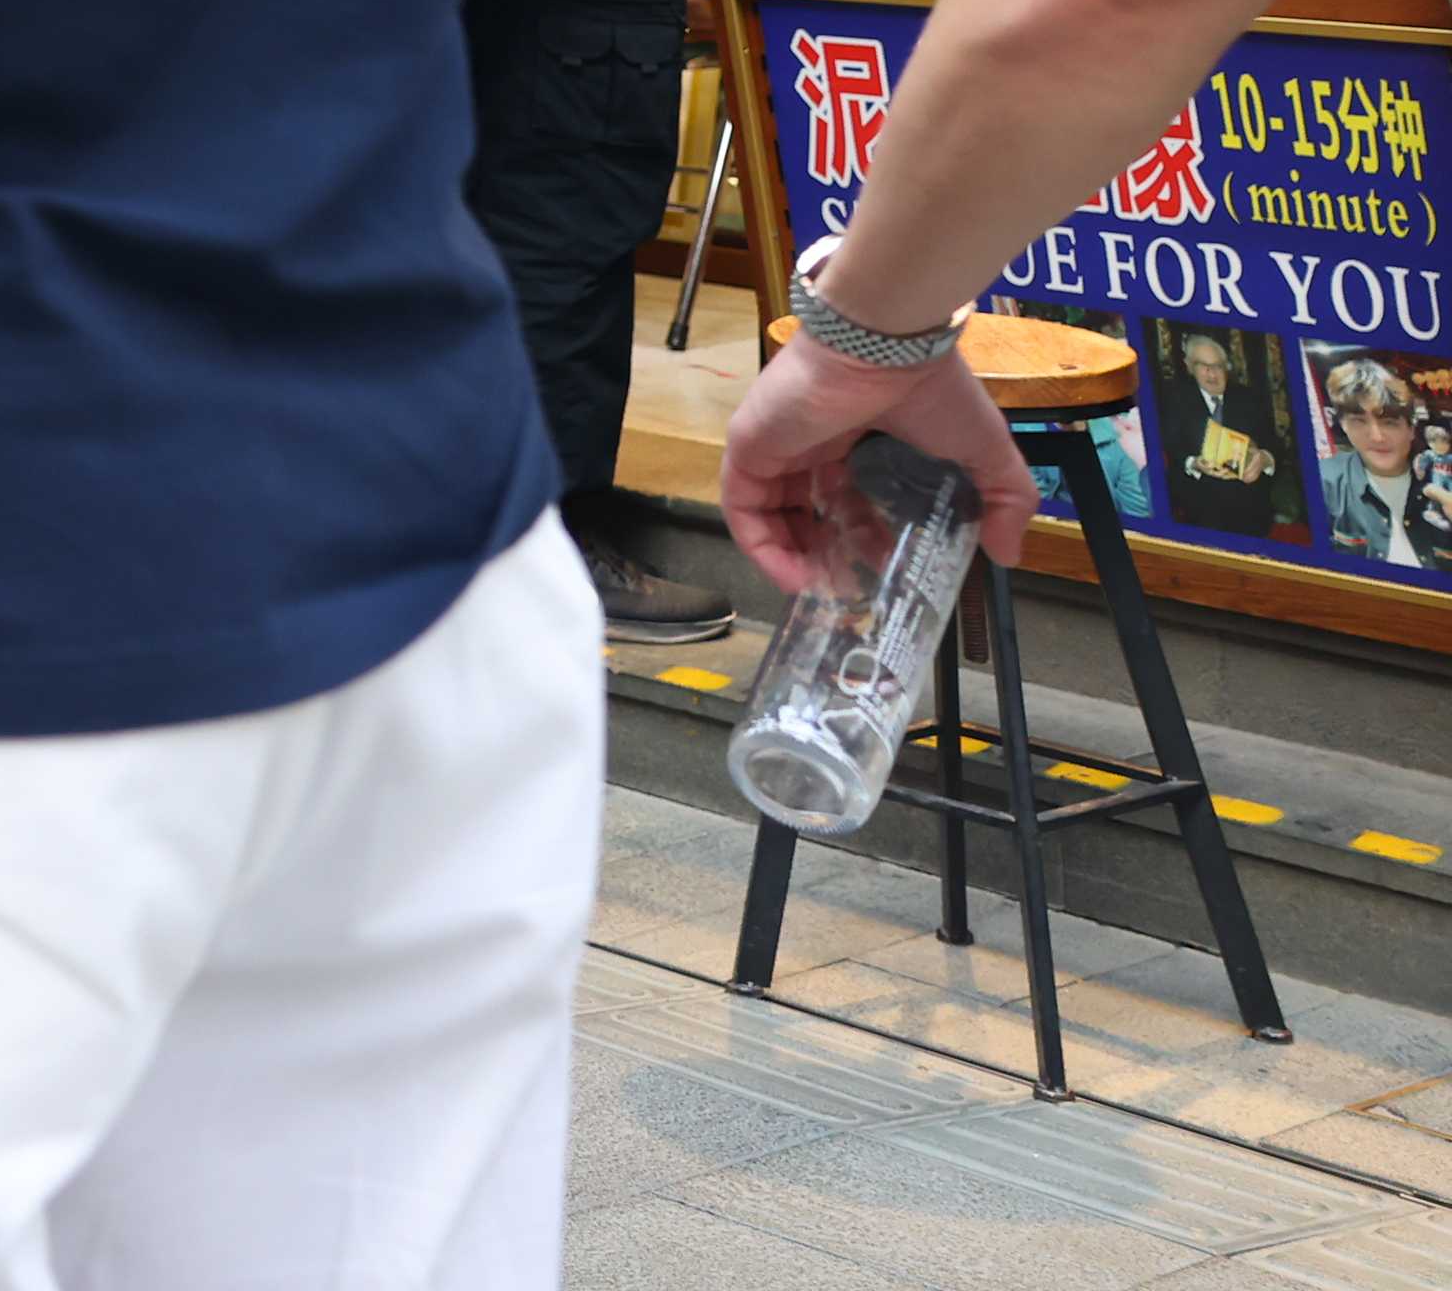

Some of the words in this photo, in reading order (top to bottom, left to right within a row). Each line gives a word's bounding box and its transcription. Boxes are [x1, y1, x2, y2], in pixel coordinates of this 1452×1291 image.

[1210, 71, 1428, 182] 10-15分钟
[1099, 231, 1259, 318] FOR
[1268, 250, 1442, 341] YOU
